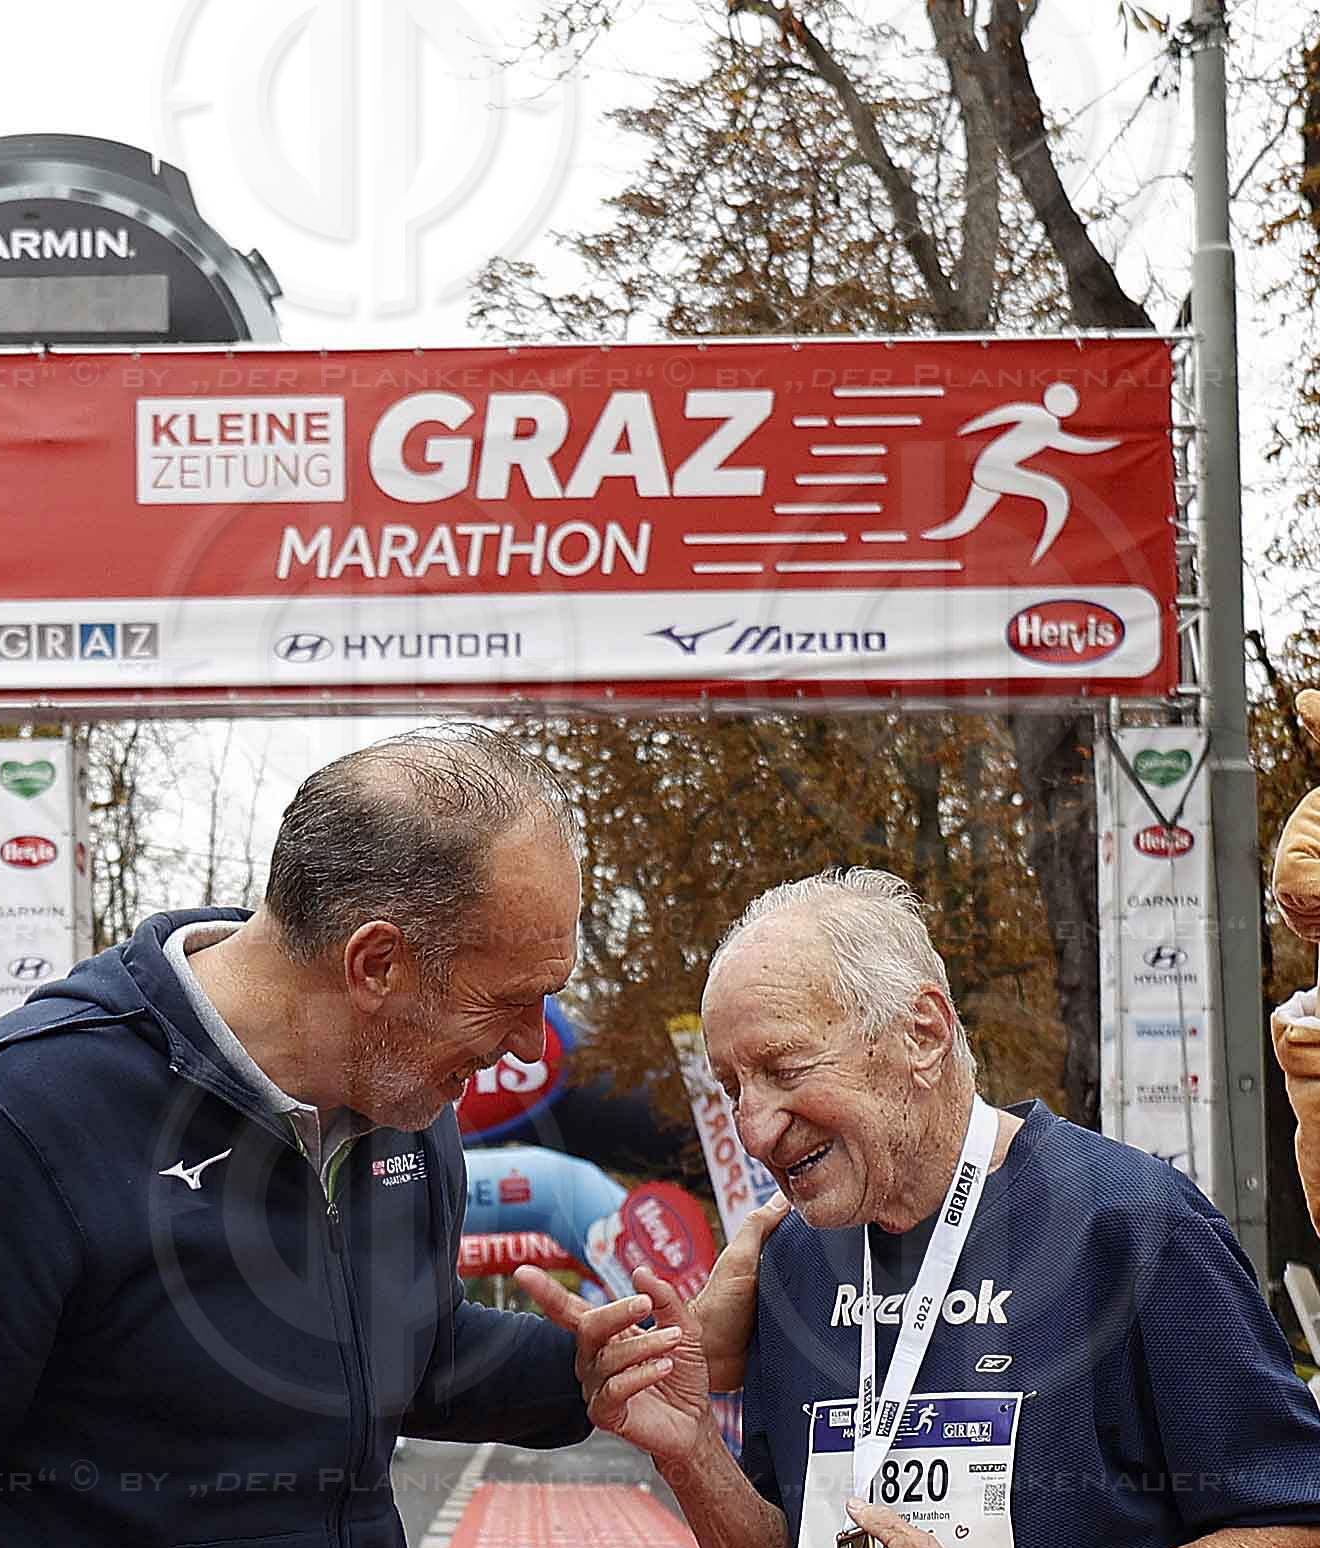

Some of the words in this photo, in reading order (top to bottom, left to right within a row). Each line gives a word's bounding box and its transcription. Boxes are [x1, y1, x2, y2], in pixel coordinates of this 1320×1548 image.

[152, 413, 330, 447] KLEINE
[369, 390, 774, 503] GRAZ
[151, 453, 332, 491] ZEITUNG
[278, 521, 652, 581] MARATHON
[344, 633, 521, 660] HYUNDAI
[1018, 614, 1116, 654] Hervis
[386, 1153, 418, 1174] GRAZ
[946, 1162, 977, 1227] GRAZ
[914, 1295, 934, 1331] 2022
[943, 1422, 992, 1437] GRAZ
[912, 1510, 950, 1521] Marathon
